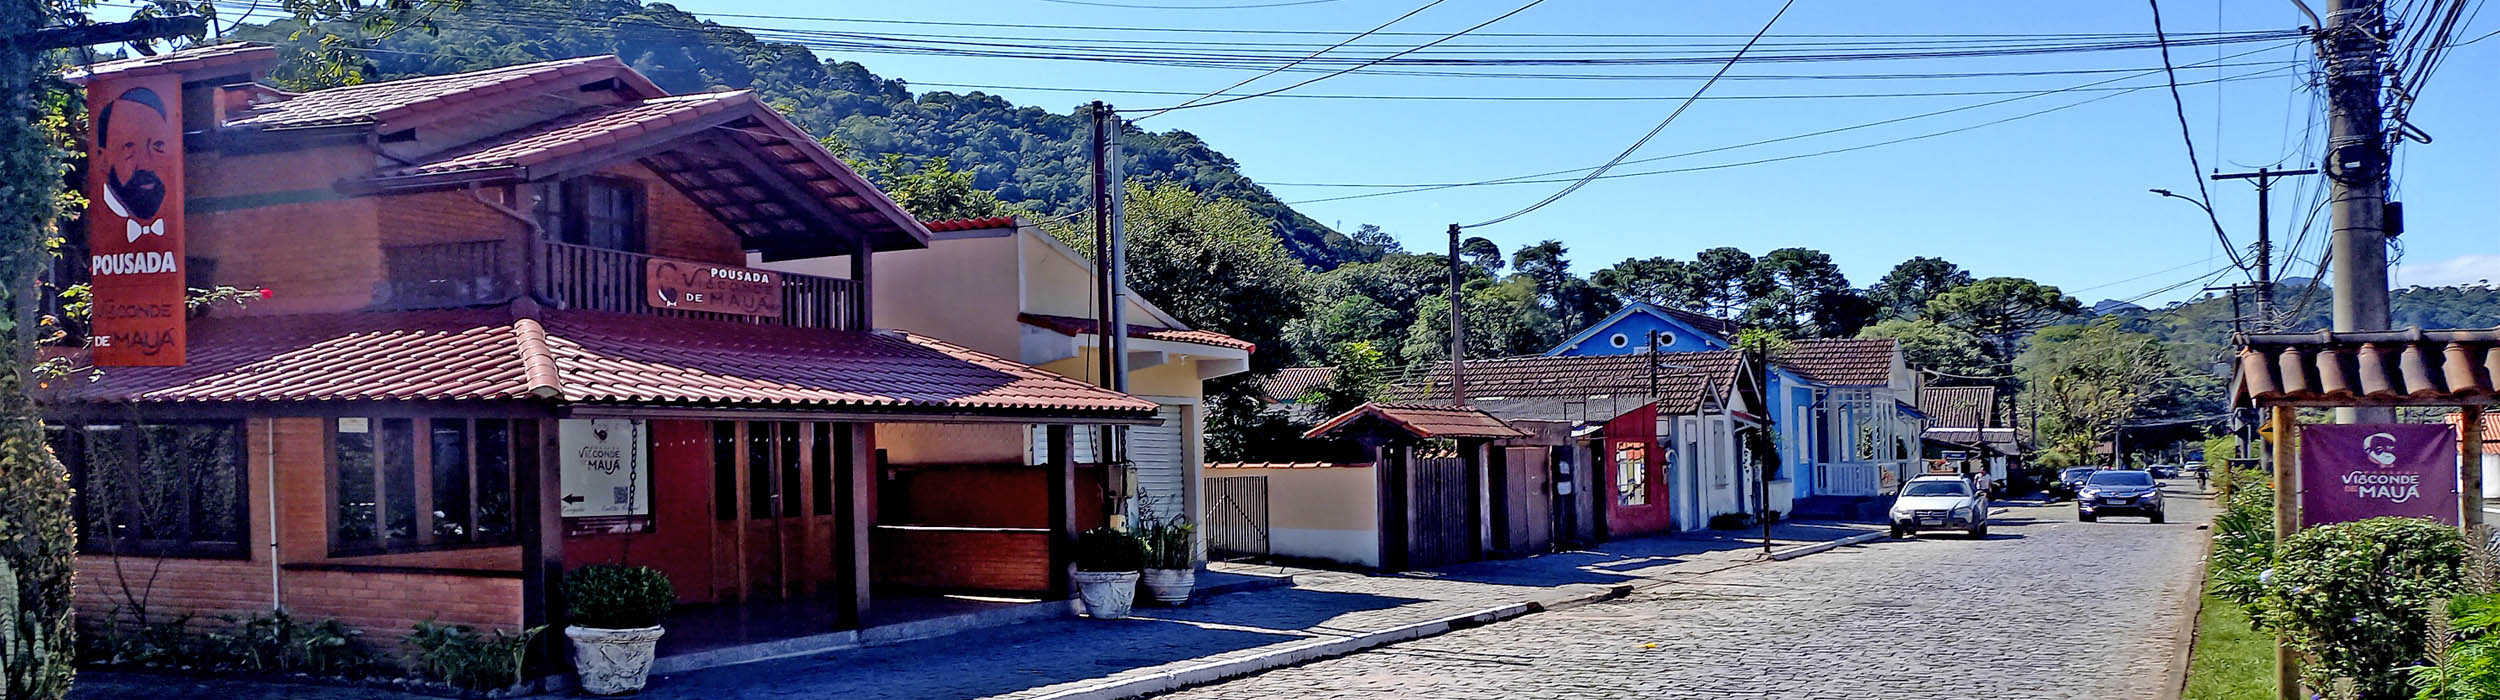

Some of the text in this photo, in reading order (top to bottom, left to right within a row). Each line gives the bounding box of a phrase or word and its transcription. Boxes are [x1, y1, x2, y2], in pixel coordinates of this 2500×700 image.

[92, 251, 176, 275] POUSADA
[710, 267, 769, 284] POUSADA
[685, 292, 703, 303] DE
[94, 335, 111, 348] DE
[2344, 484, 2420, 503] DE MAUÁ
